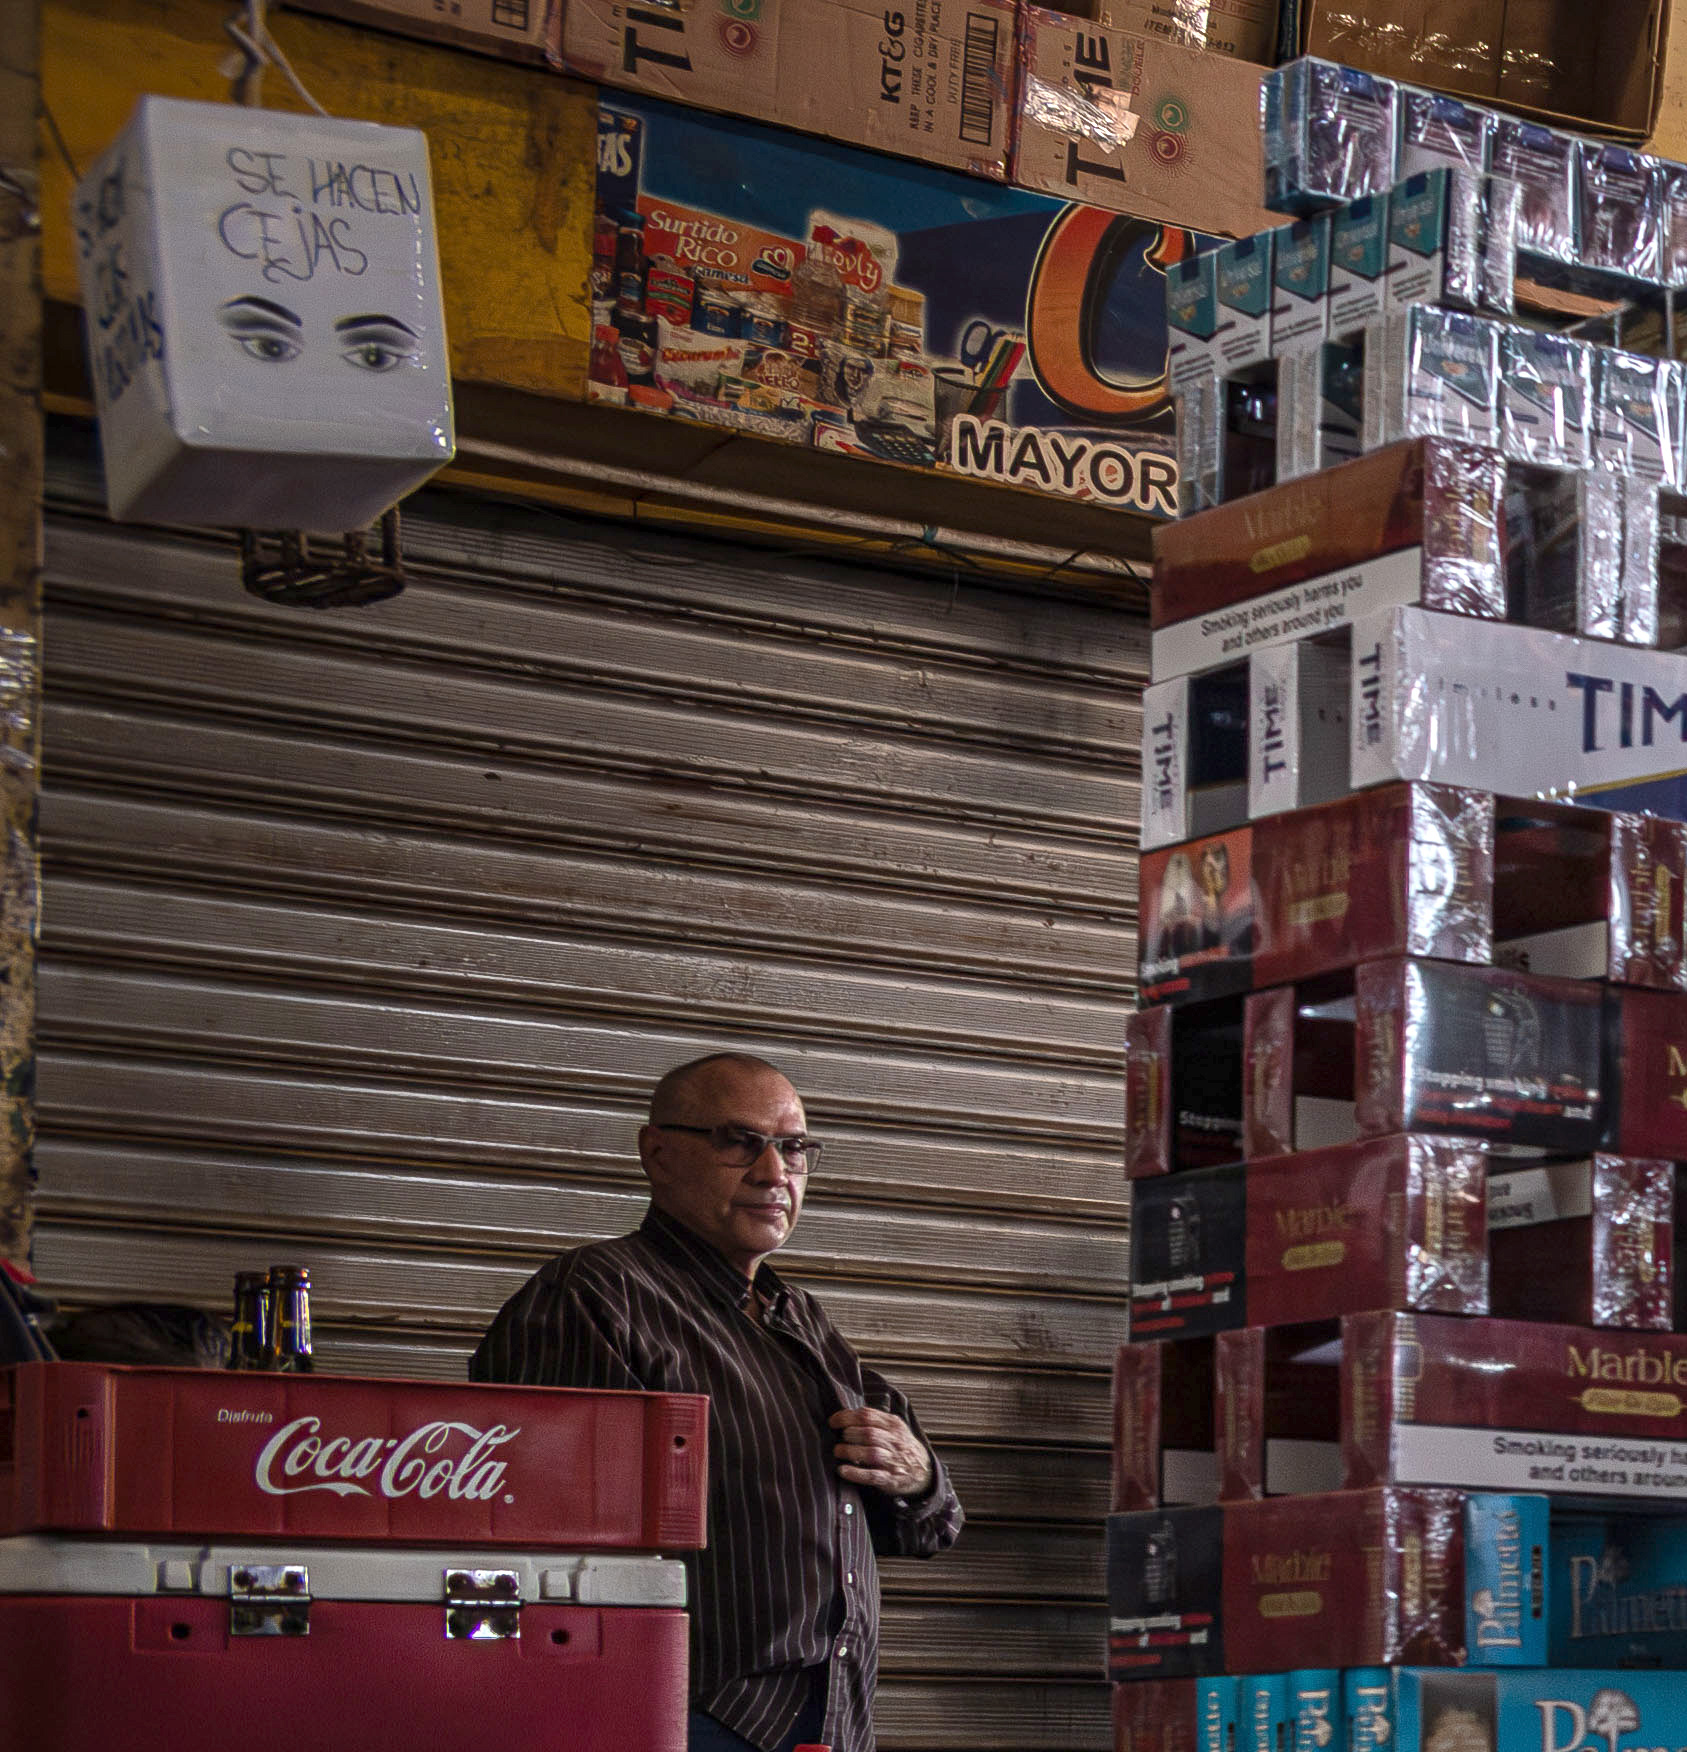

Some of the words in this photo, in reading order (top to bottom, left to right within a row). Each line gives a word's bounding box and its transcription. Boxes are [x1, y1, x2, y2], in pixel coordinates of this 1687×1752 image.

[879, 11, 905, 104] KT&G
[911, 66, 922, 97] THESE
[925, 73, 937, 105] COOL
[309, 157, 422, 217] HACEN
[647, 210, 738, 247] Surtido
[1201, 613, 1250, 638] Smoking
[1251, 594, 1301, 624] seriously
[1245, 620, 1281, 645] others
[1282, 609, 1321, 634] around
[1358, 642, 1382, 744] TIME
[1262, 683, 1287, 784] TIME
[1151, 711, 1174, 811] TIME
[216, 1408, 274, 1425] Disfruta
[256, 1415, 521, 1502] Coca-Cola
[1493, 1435, 1576, 1465] Smoking
[1580, 1439, 1668, 1469] seriously
[1529, 1460, 1564, 1482] and
[1567, 1461, 1628, 1486] others
[1474, 1508, 1521, 1650] Palmetto
